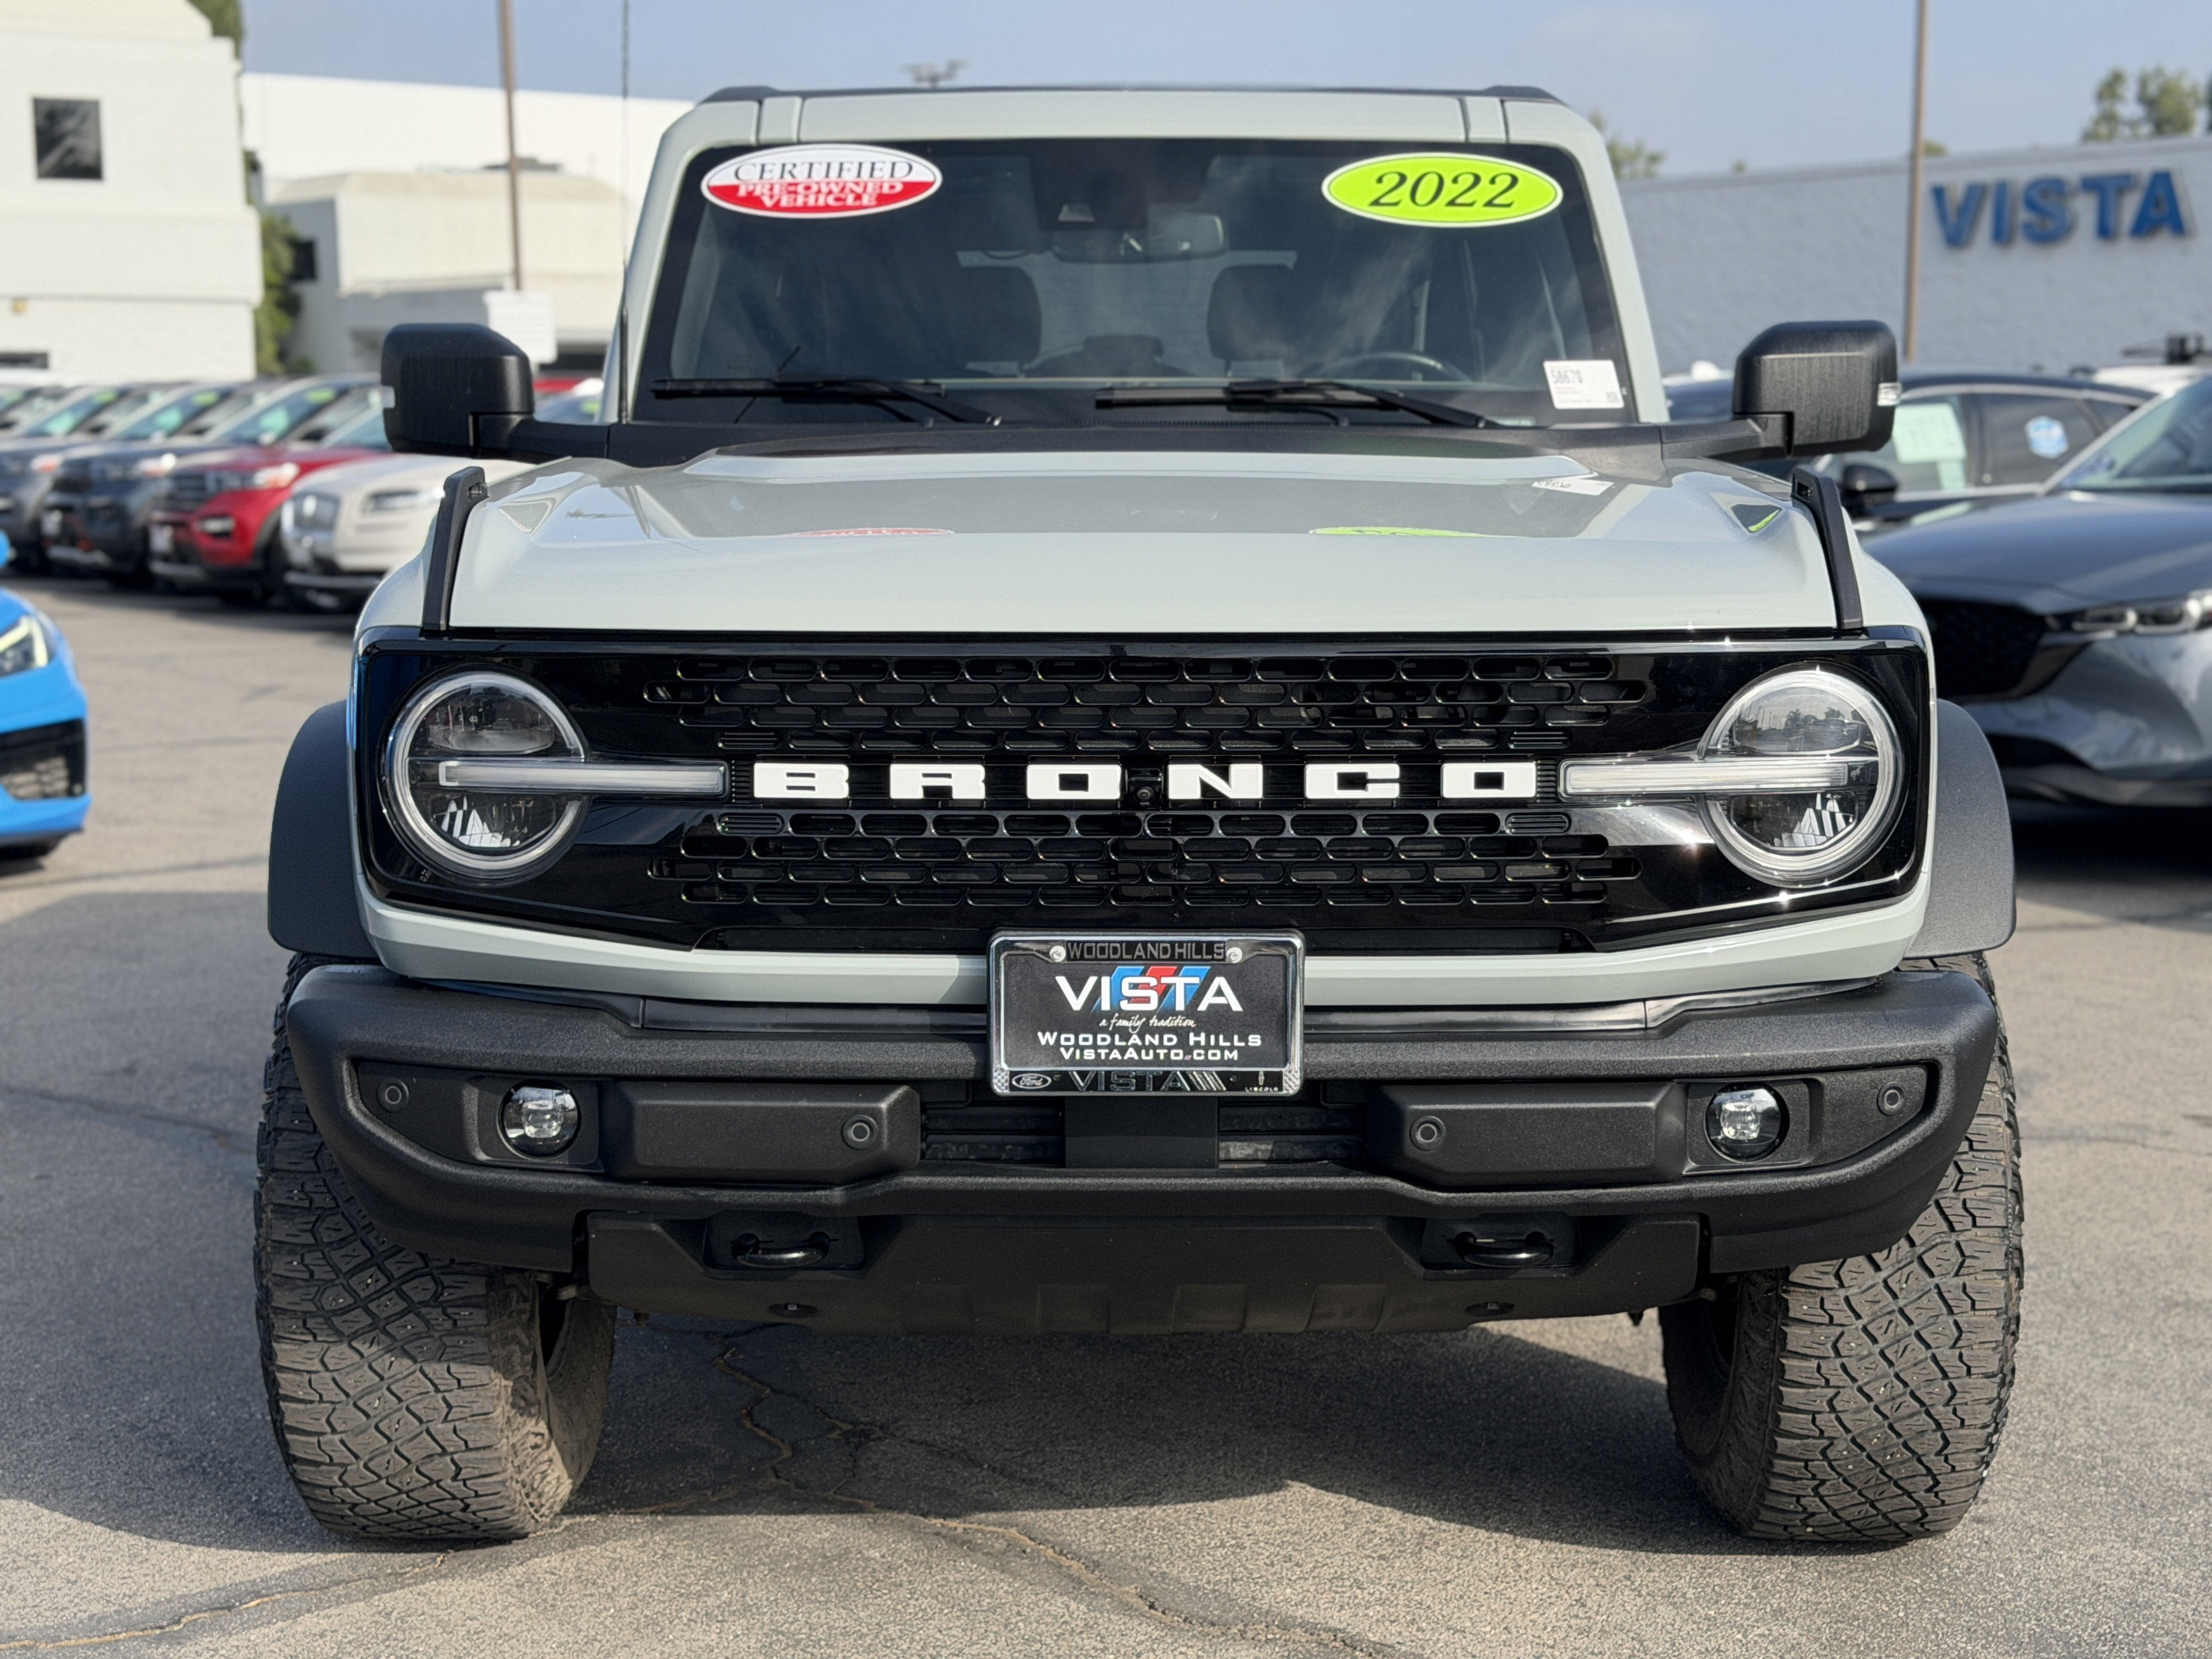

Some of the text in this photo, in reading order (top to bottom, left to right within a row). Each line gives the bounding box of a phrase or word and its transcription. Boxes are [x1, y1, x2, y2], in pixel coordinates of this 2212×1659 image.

[734, 161, 913, 182] CERTIFIED
[737, 182, 904, 197] PRE-OWNED
[1368, 171, 1520, 208] 2022
[760, 193, 878, 208] VEHICLE
[1931, 170, 2188, 247] VISTA
[753, 763, 1536, 800] BRONCO
[1068, 942, 1224, 960] WOODLAND HILLS
[1054, 975, 1244, 1012] VISTA
[1099, 1013, 1197, 1034] a family tradition
[1037, 1031, 1262, 1047] WOODLAND HILLS
[1019, 1075, 1043, 1086] Ford
[1068, 1071, 1191, 1092] VISTA
